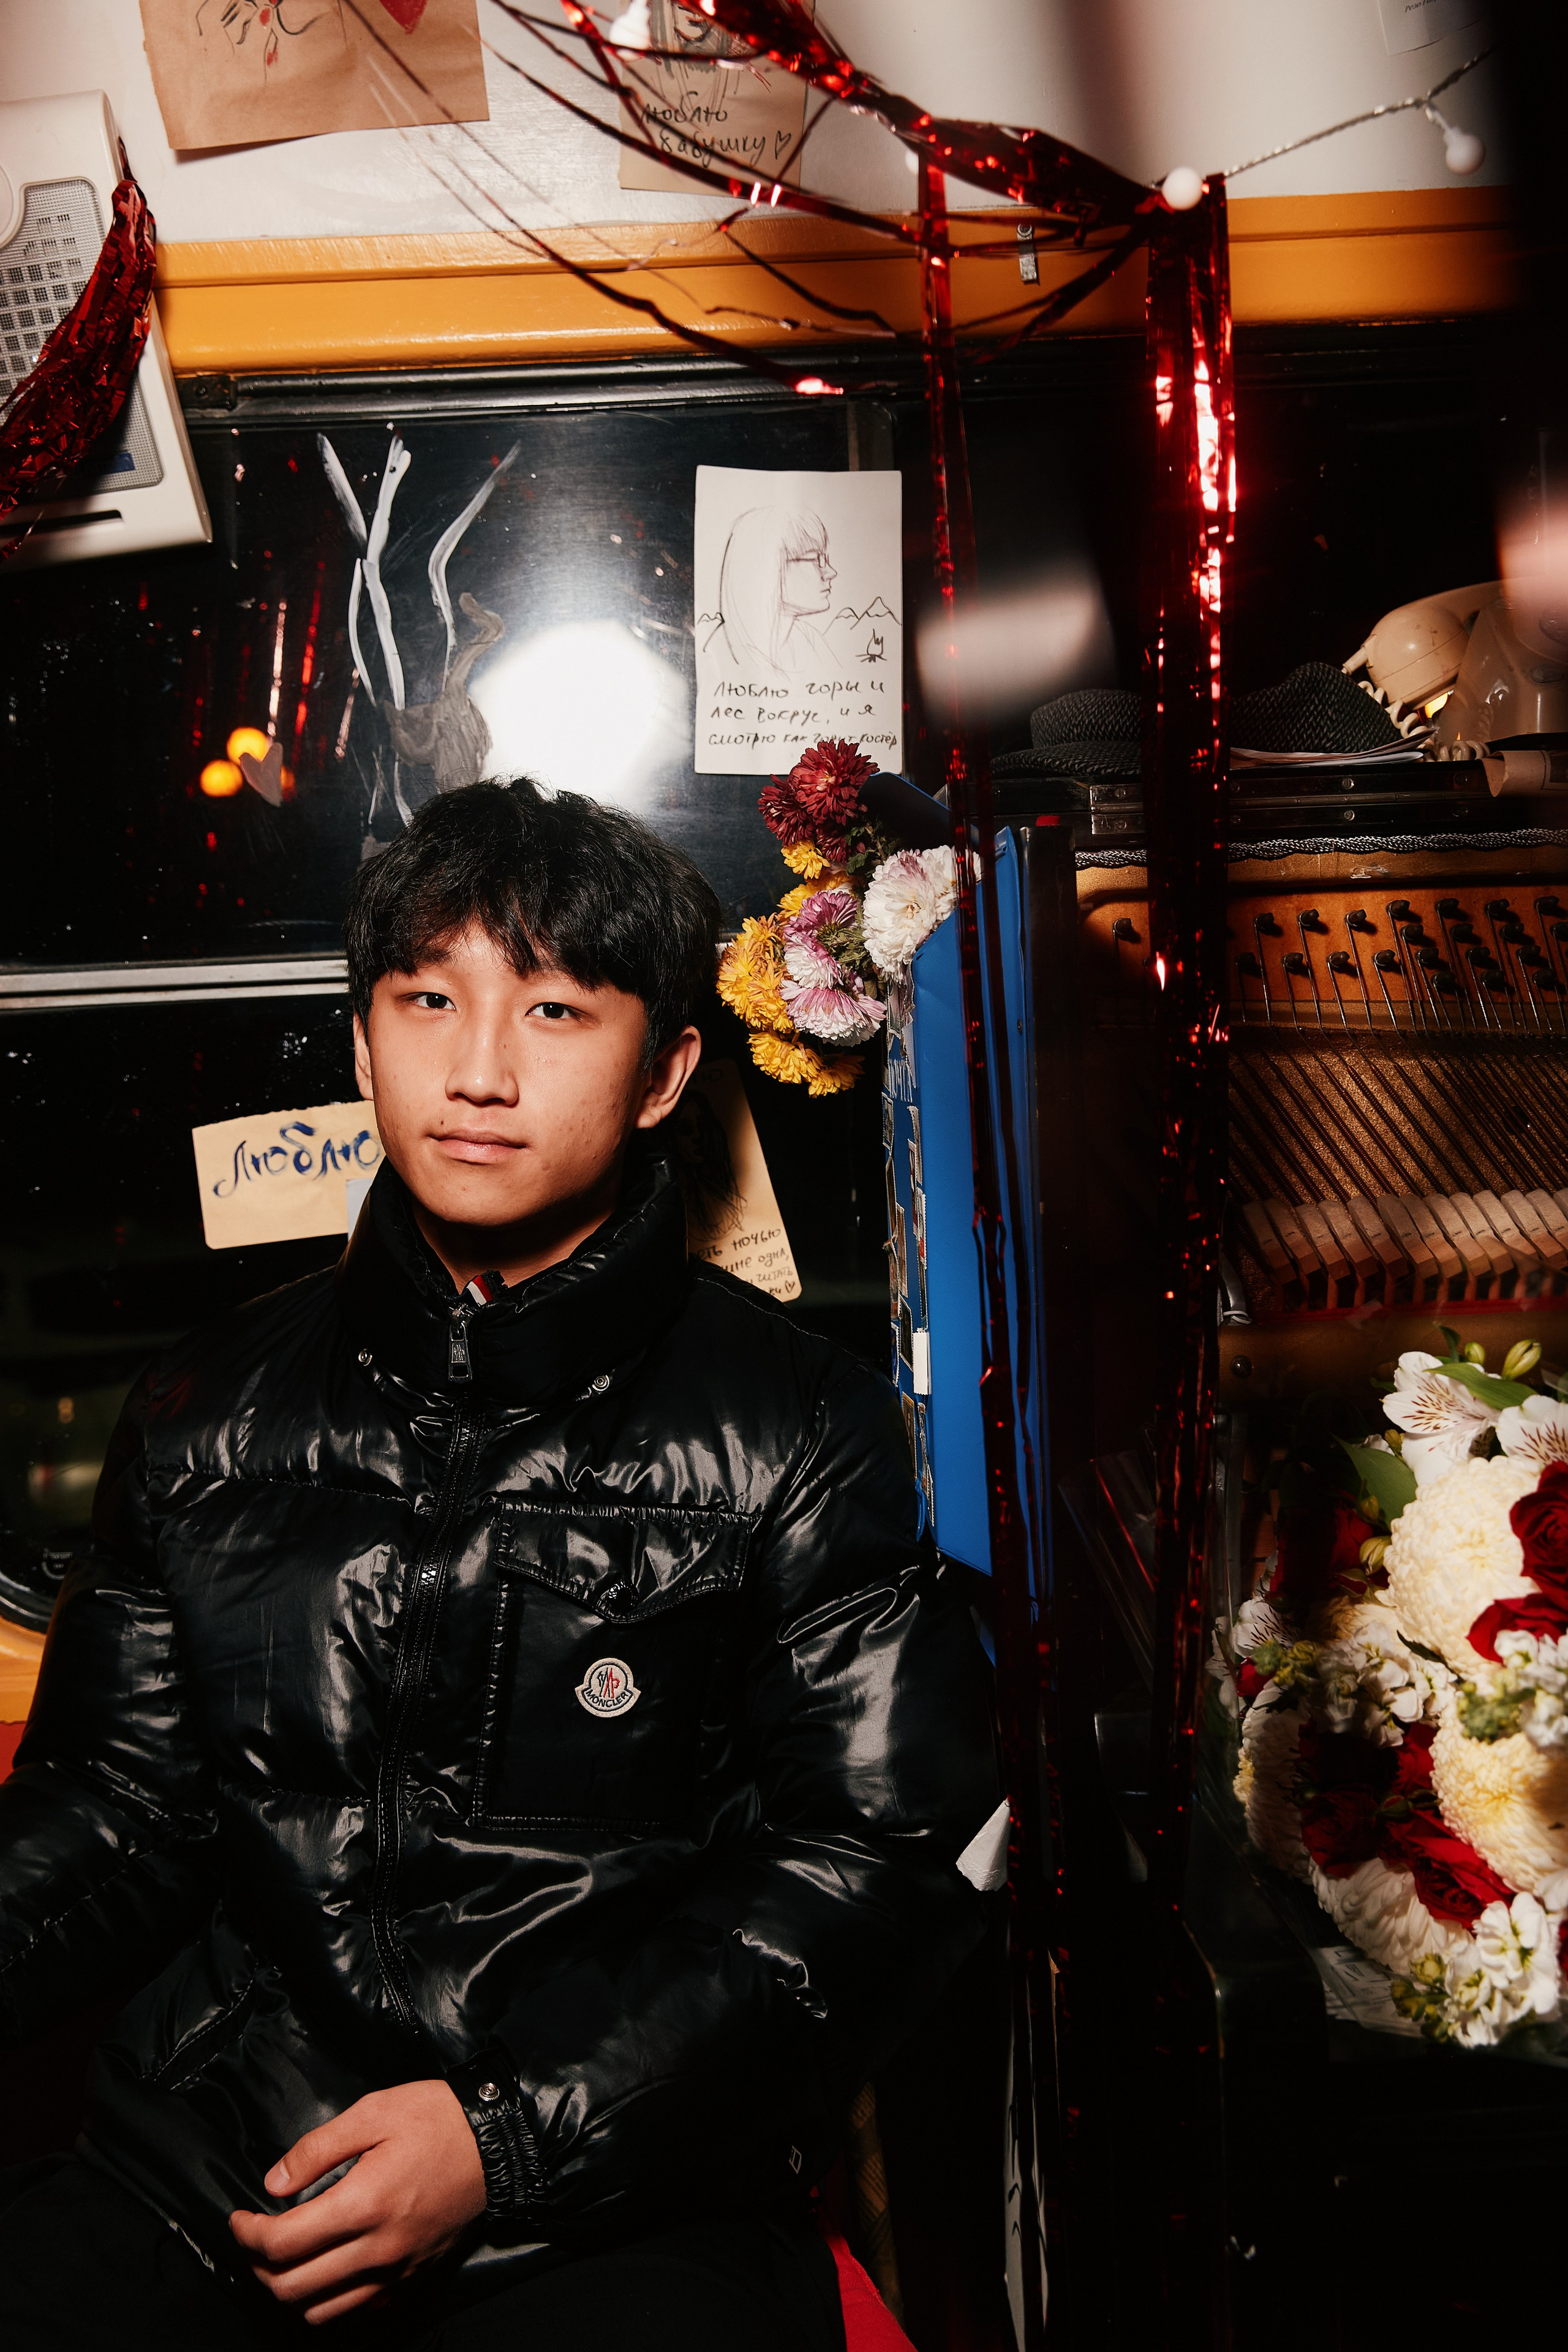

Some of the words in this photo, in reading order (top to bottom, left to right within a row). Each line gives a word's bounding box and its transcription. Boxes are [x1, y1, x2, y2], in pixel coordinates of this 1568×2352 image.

[660, 128, 766, 168] бабушку
[714, 681, 789, 698] Люблю
[805, 680, 862, 701] горы
[870, 680, 885, 693] и
[710, 706, 745, 720] лес
[840, 707, 850, 717] и
[858, 704, 876, 716] я
[709, 733, 775, 750] смотрю
[783, 733, 808, 743] как
[859, 731, 897, 750] костёр
[213, 1121, 381, 1197] Люблю
[731, 1228, 781, 1251] ночью
[758, 1247, 790, 1267] одна,
[756, 1266, 793, 1282] читать
[586, 1689, 629, 1708] MONCLER
